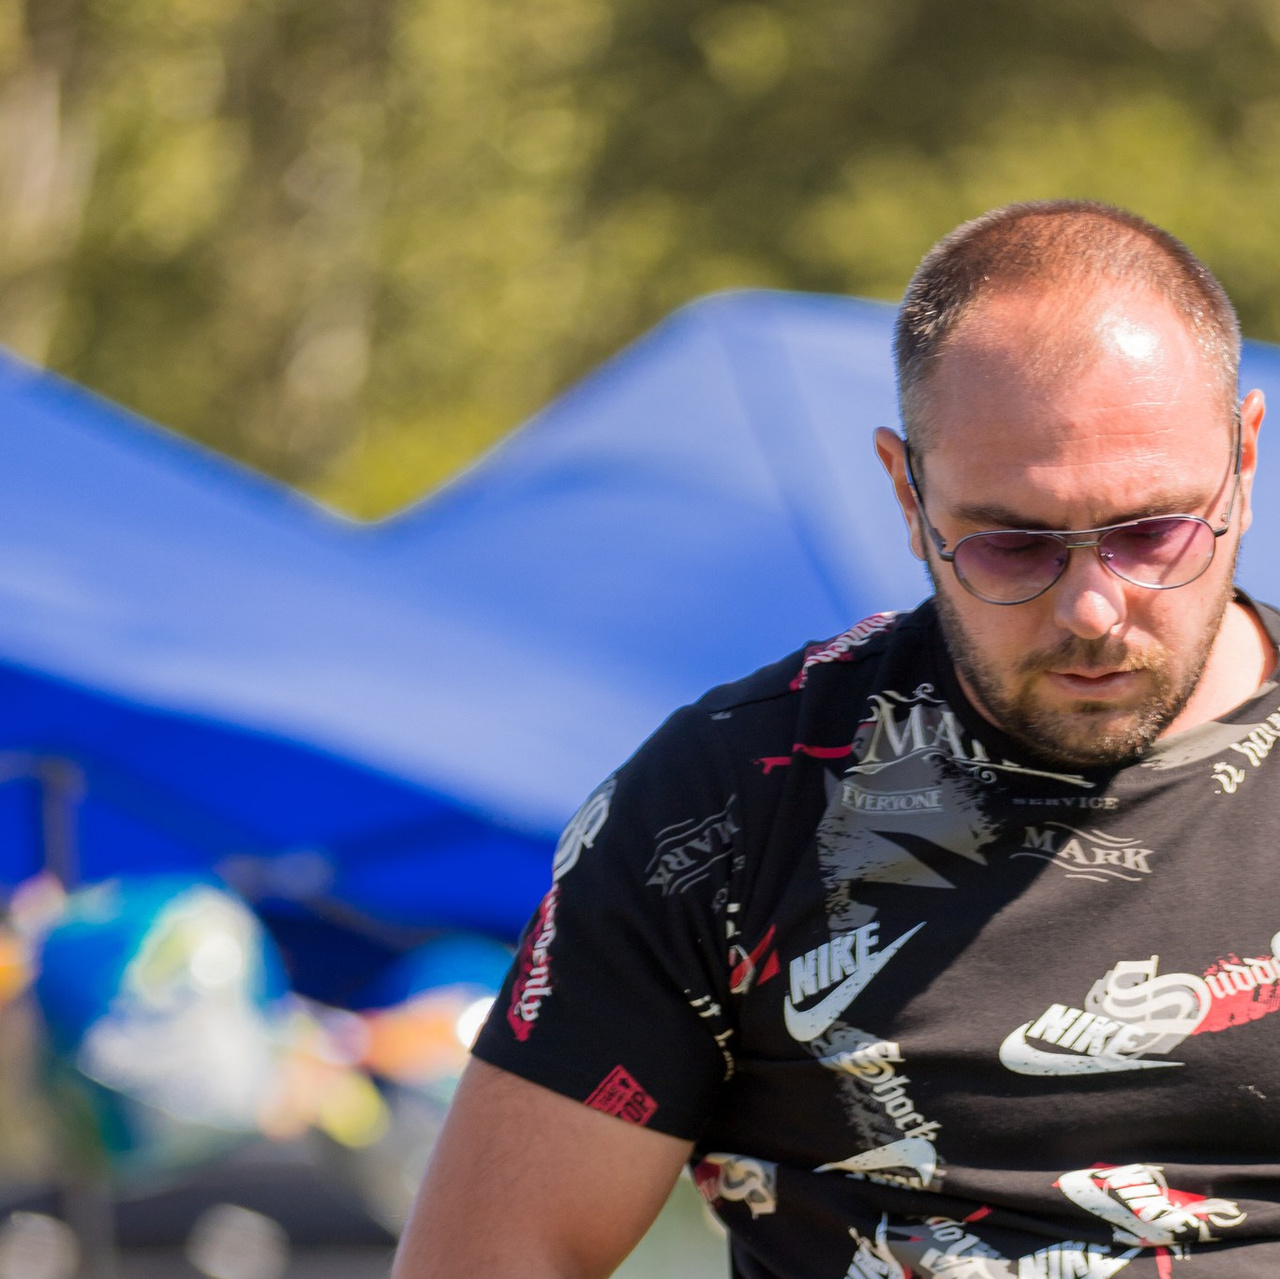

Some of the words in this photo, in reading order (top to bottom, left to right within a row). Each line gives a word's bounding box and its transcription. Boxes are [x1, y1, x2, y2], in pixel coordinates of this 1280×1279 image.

[843, 785, 942, 812] EVERYONE
[1012, 796, 1119, 811] SERVICE
[1021, 826, 1155, 874] MARK
[789, 921, 881, 1004] NIKE
[1026, 1003, 1146, 1058] NIKE
